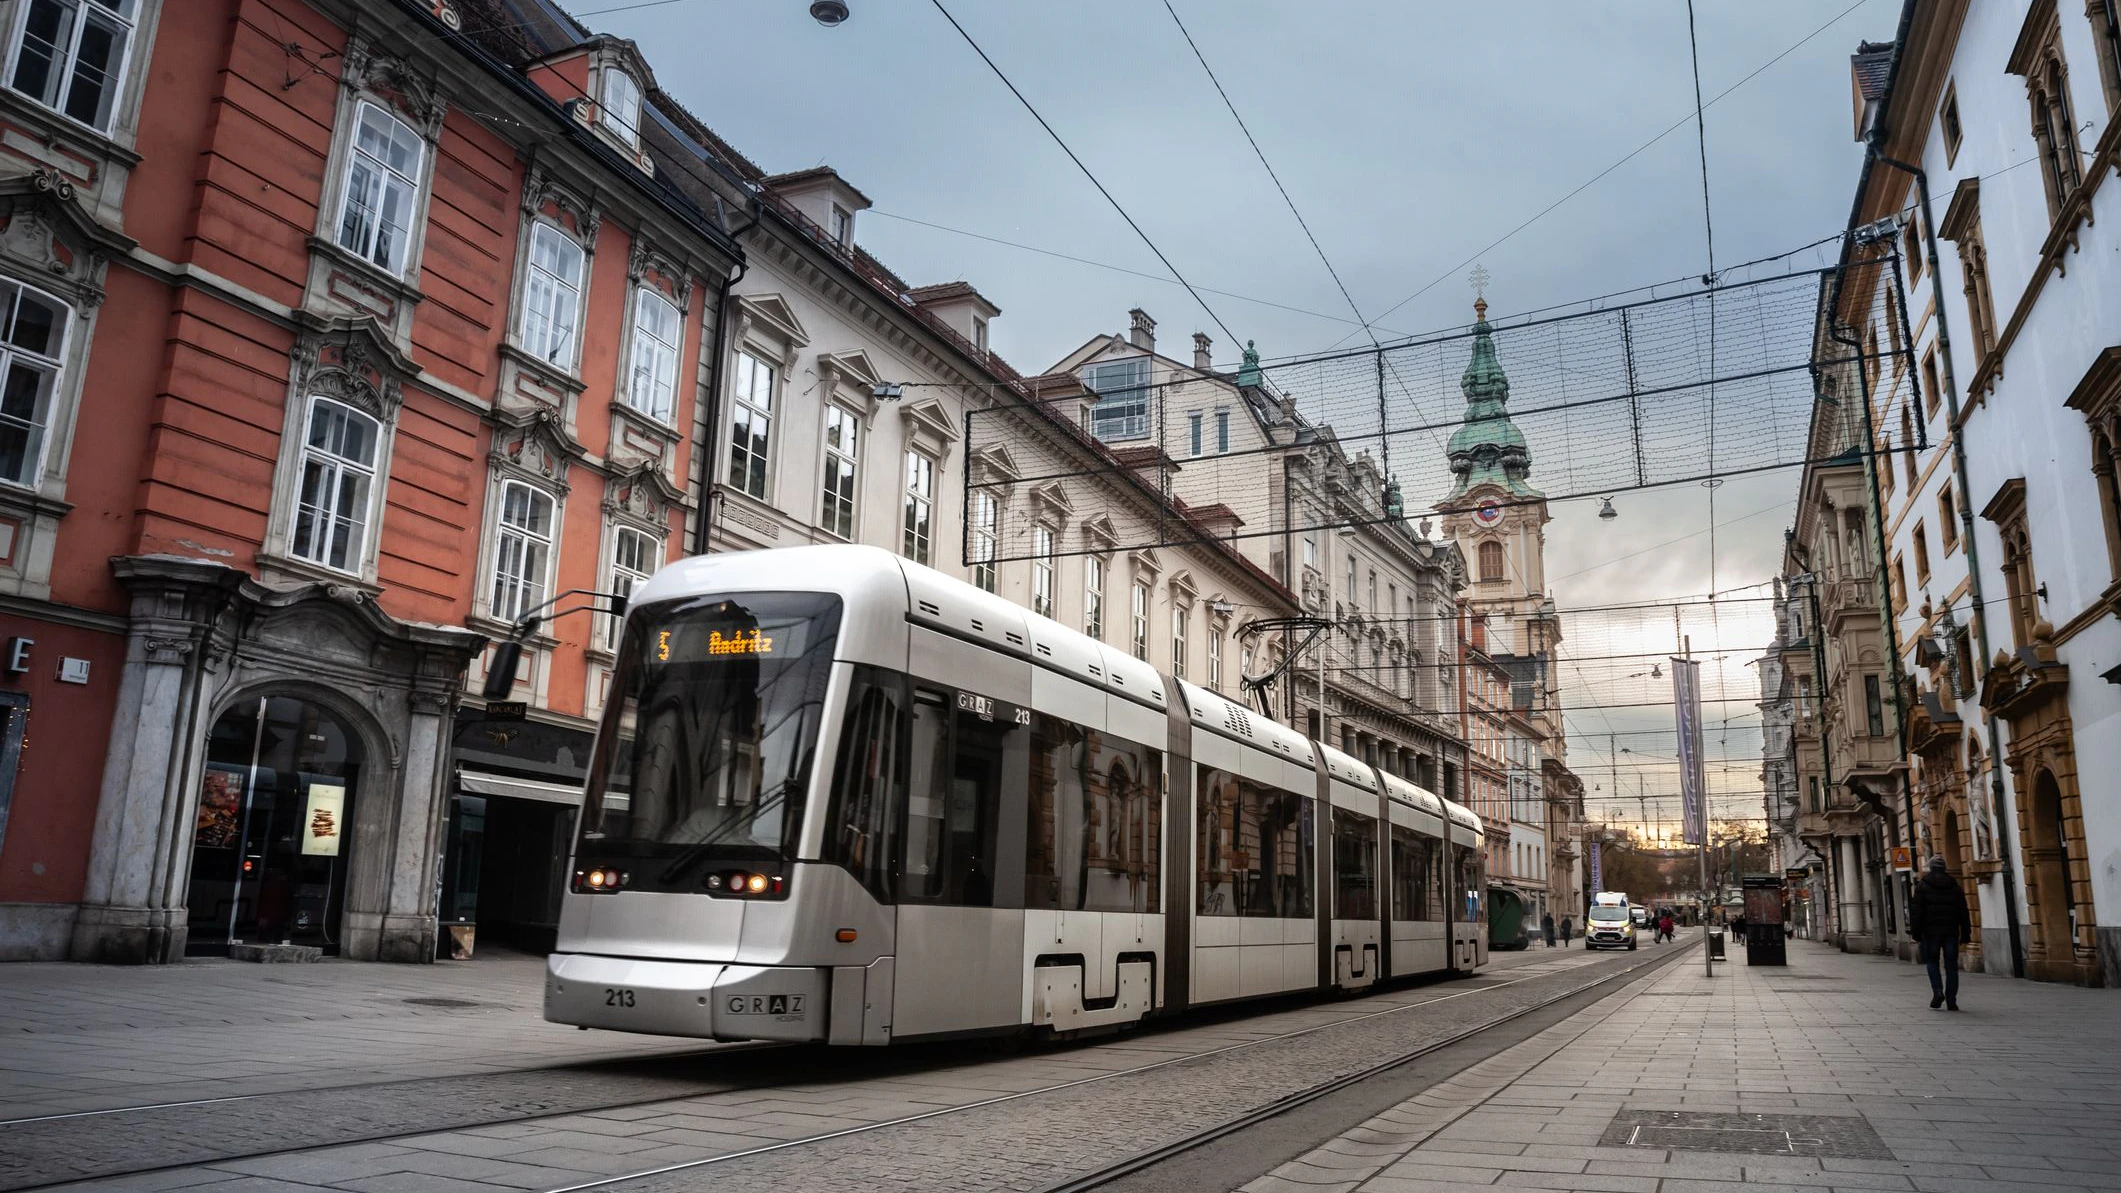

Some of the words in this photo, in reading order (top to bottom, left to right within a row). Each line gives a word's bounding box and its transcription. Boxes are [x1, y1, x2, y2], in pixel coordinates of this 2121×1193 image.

[659, 630, 671, 660] 5
[959, 693, 992, 714] GRAZ
[1015, 708, 1030, 725] 213
[605, 988, 636, 1008] 213
[728, 996, 802, 1013] GRAZ
